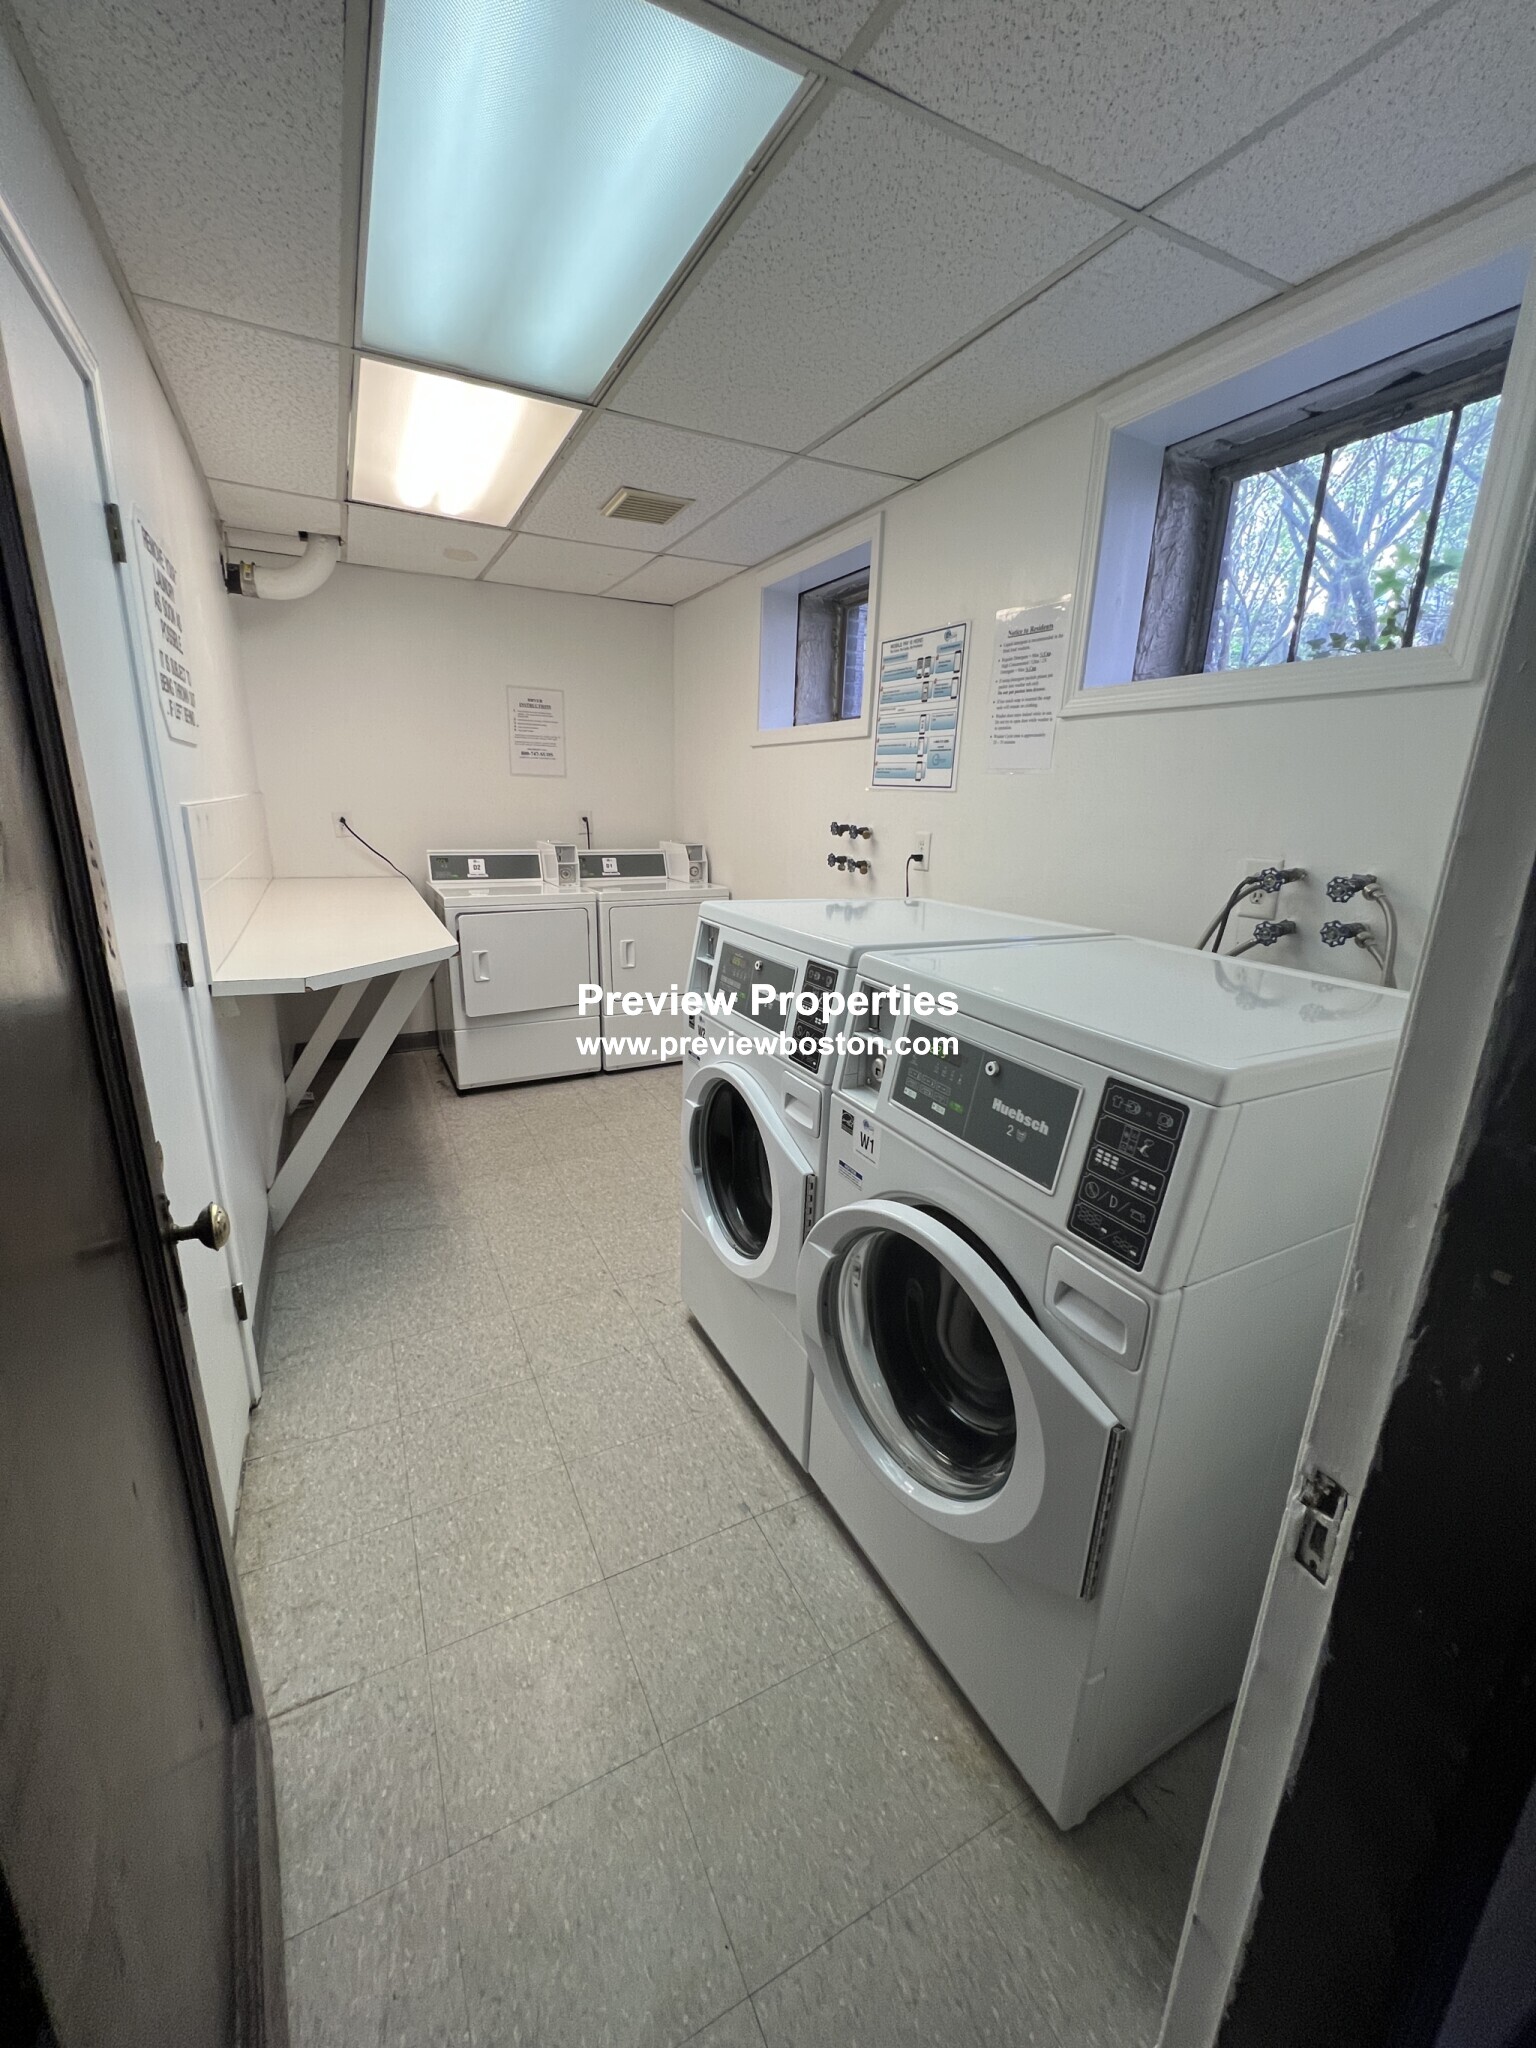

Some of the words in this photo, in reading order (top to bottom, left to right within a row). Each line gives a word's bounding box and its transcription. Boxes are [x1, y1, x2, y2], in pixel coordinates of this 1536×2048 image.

[1008, 629, 1023, 637] Notice
[1030, 624, 1054, 633] Residents
[991, 1097, 1050, 1136] Huebsch
[1006, 1124, 1014, 1137] 2
[860, 1131, 874, 1154] W1
